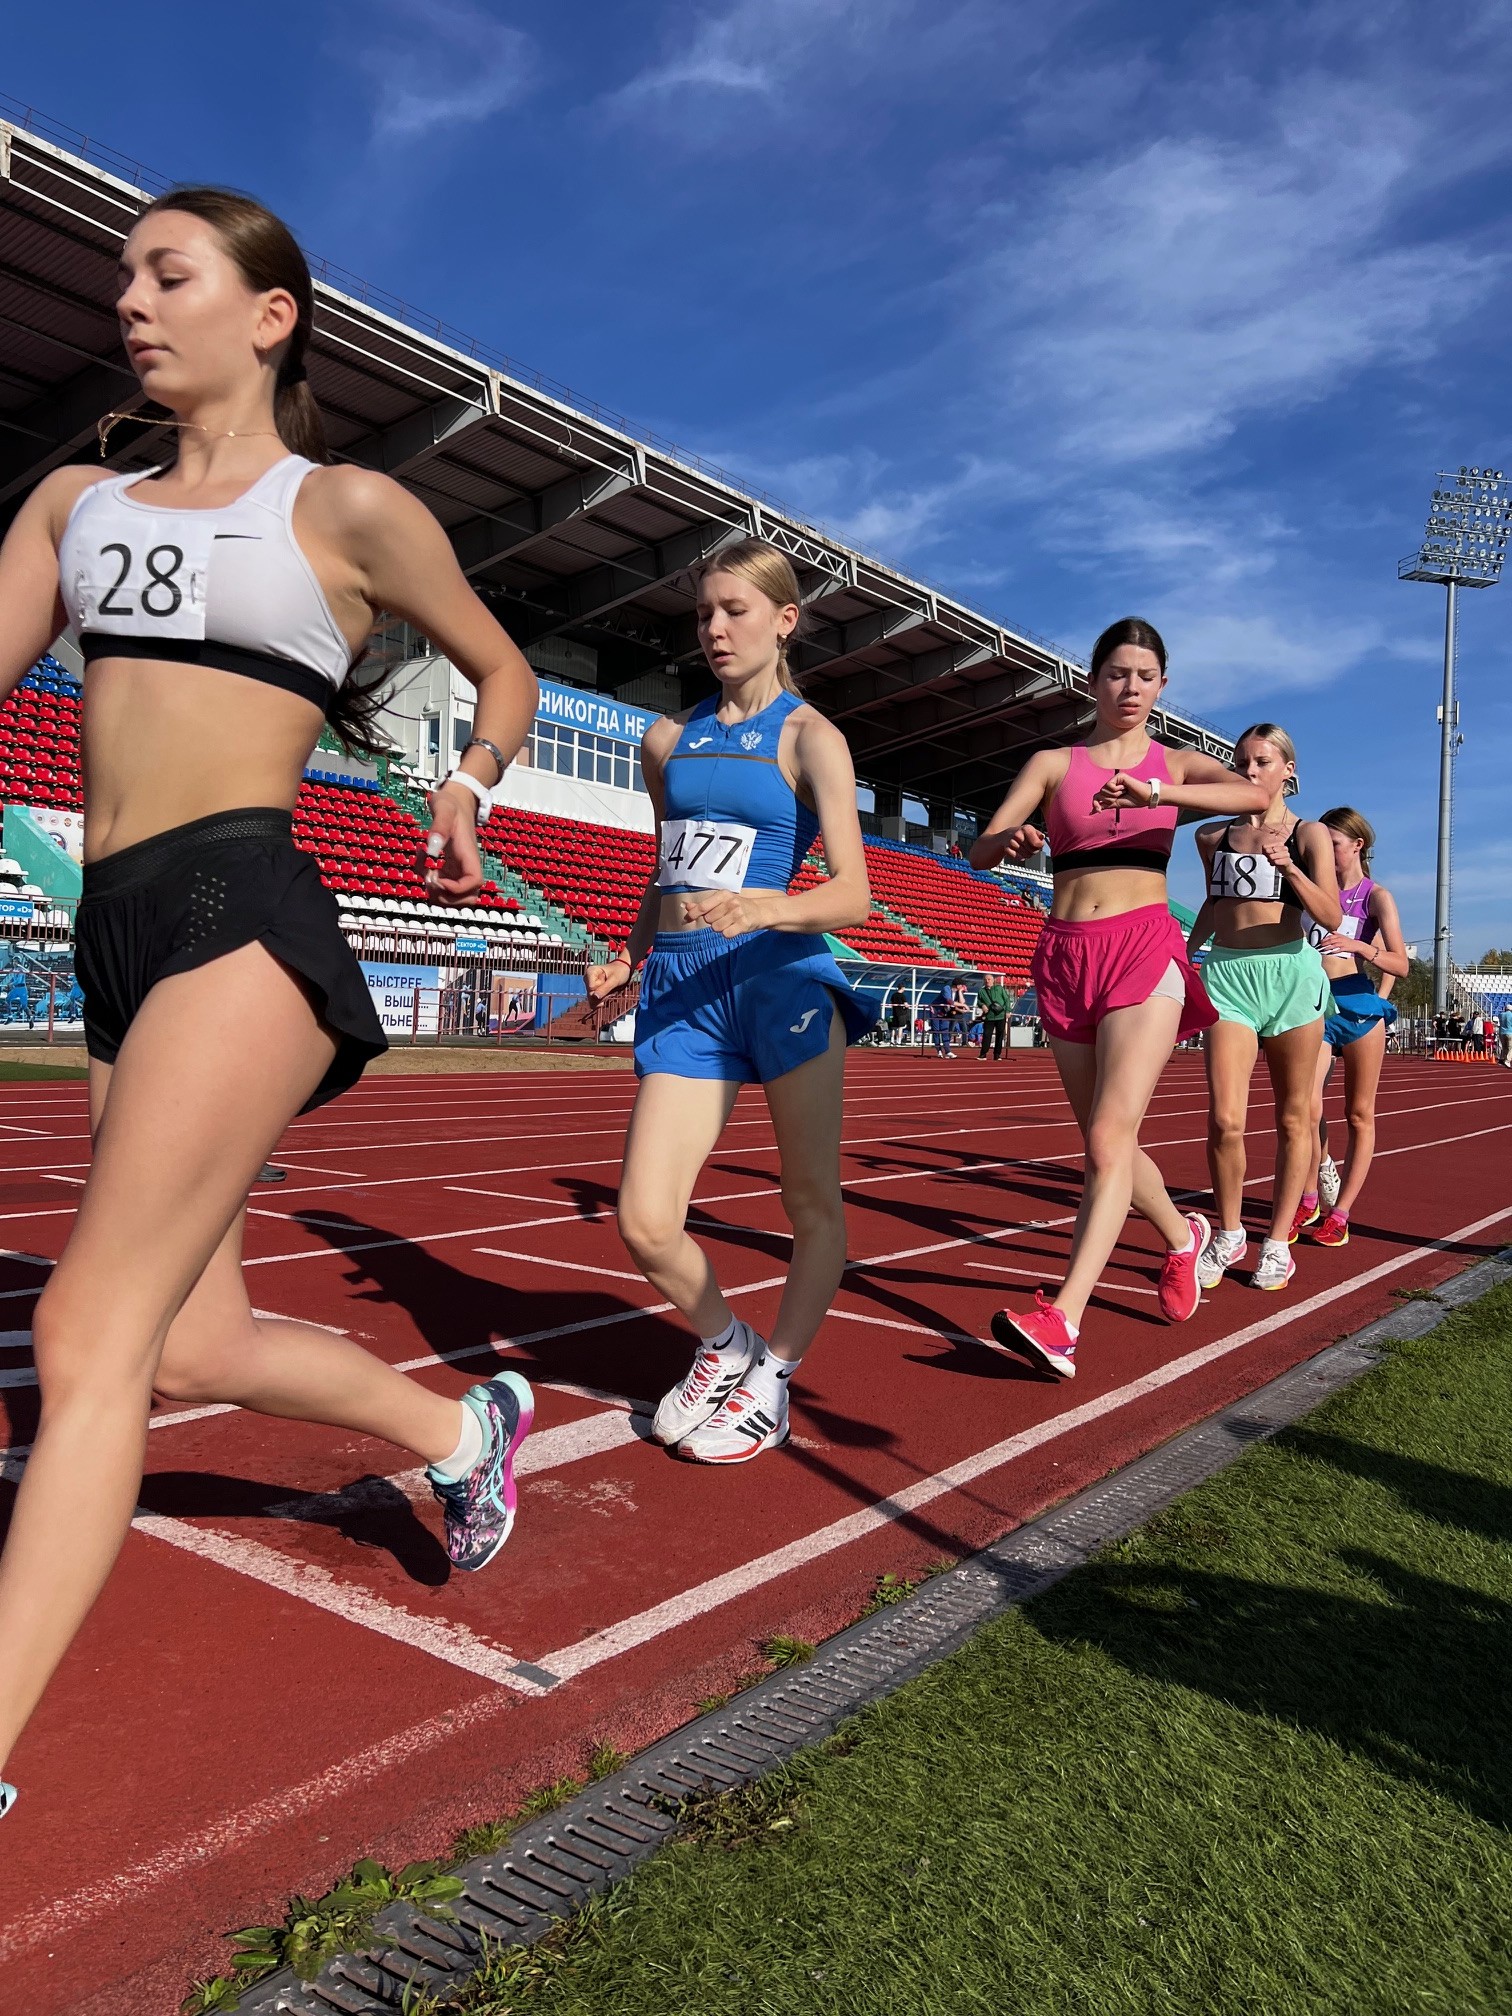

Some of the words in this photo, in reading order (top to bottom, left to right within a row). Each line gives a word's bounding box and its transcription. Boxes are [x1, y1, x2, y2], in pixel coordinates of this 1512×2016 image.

[97, 543, 184, 617] 28
[538, 688, 620, 733] НИКОГДА
[625, 713, 645, 738] НЕ
[668, 832, 742, 874] 477
[368, 974, 422, 988] БЫСТРЕЕ
